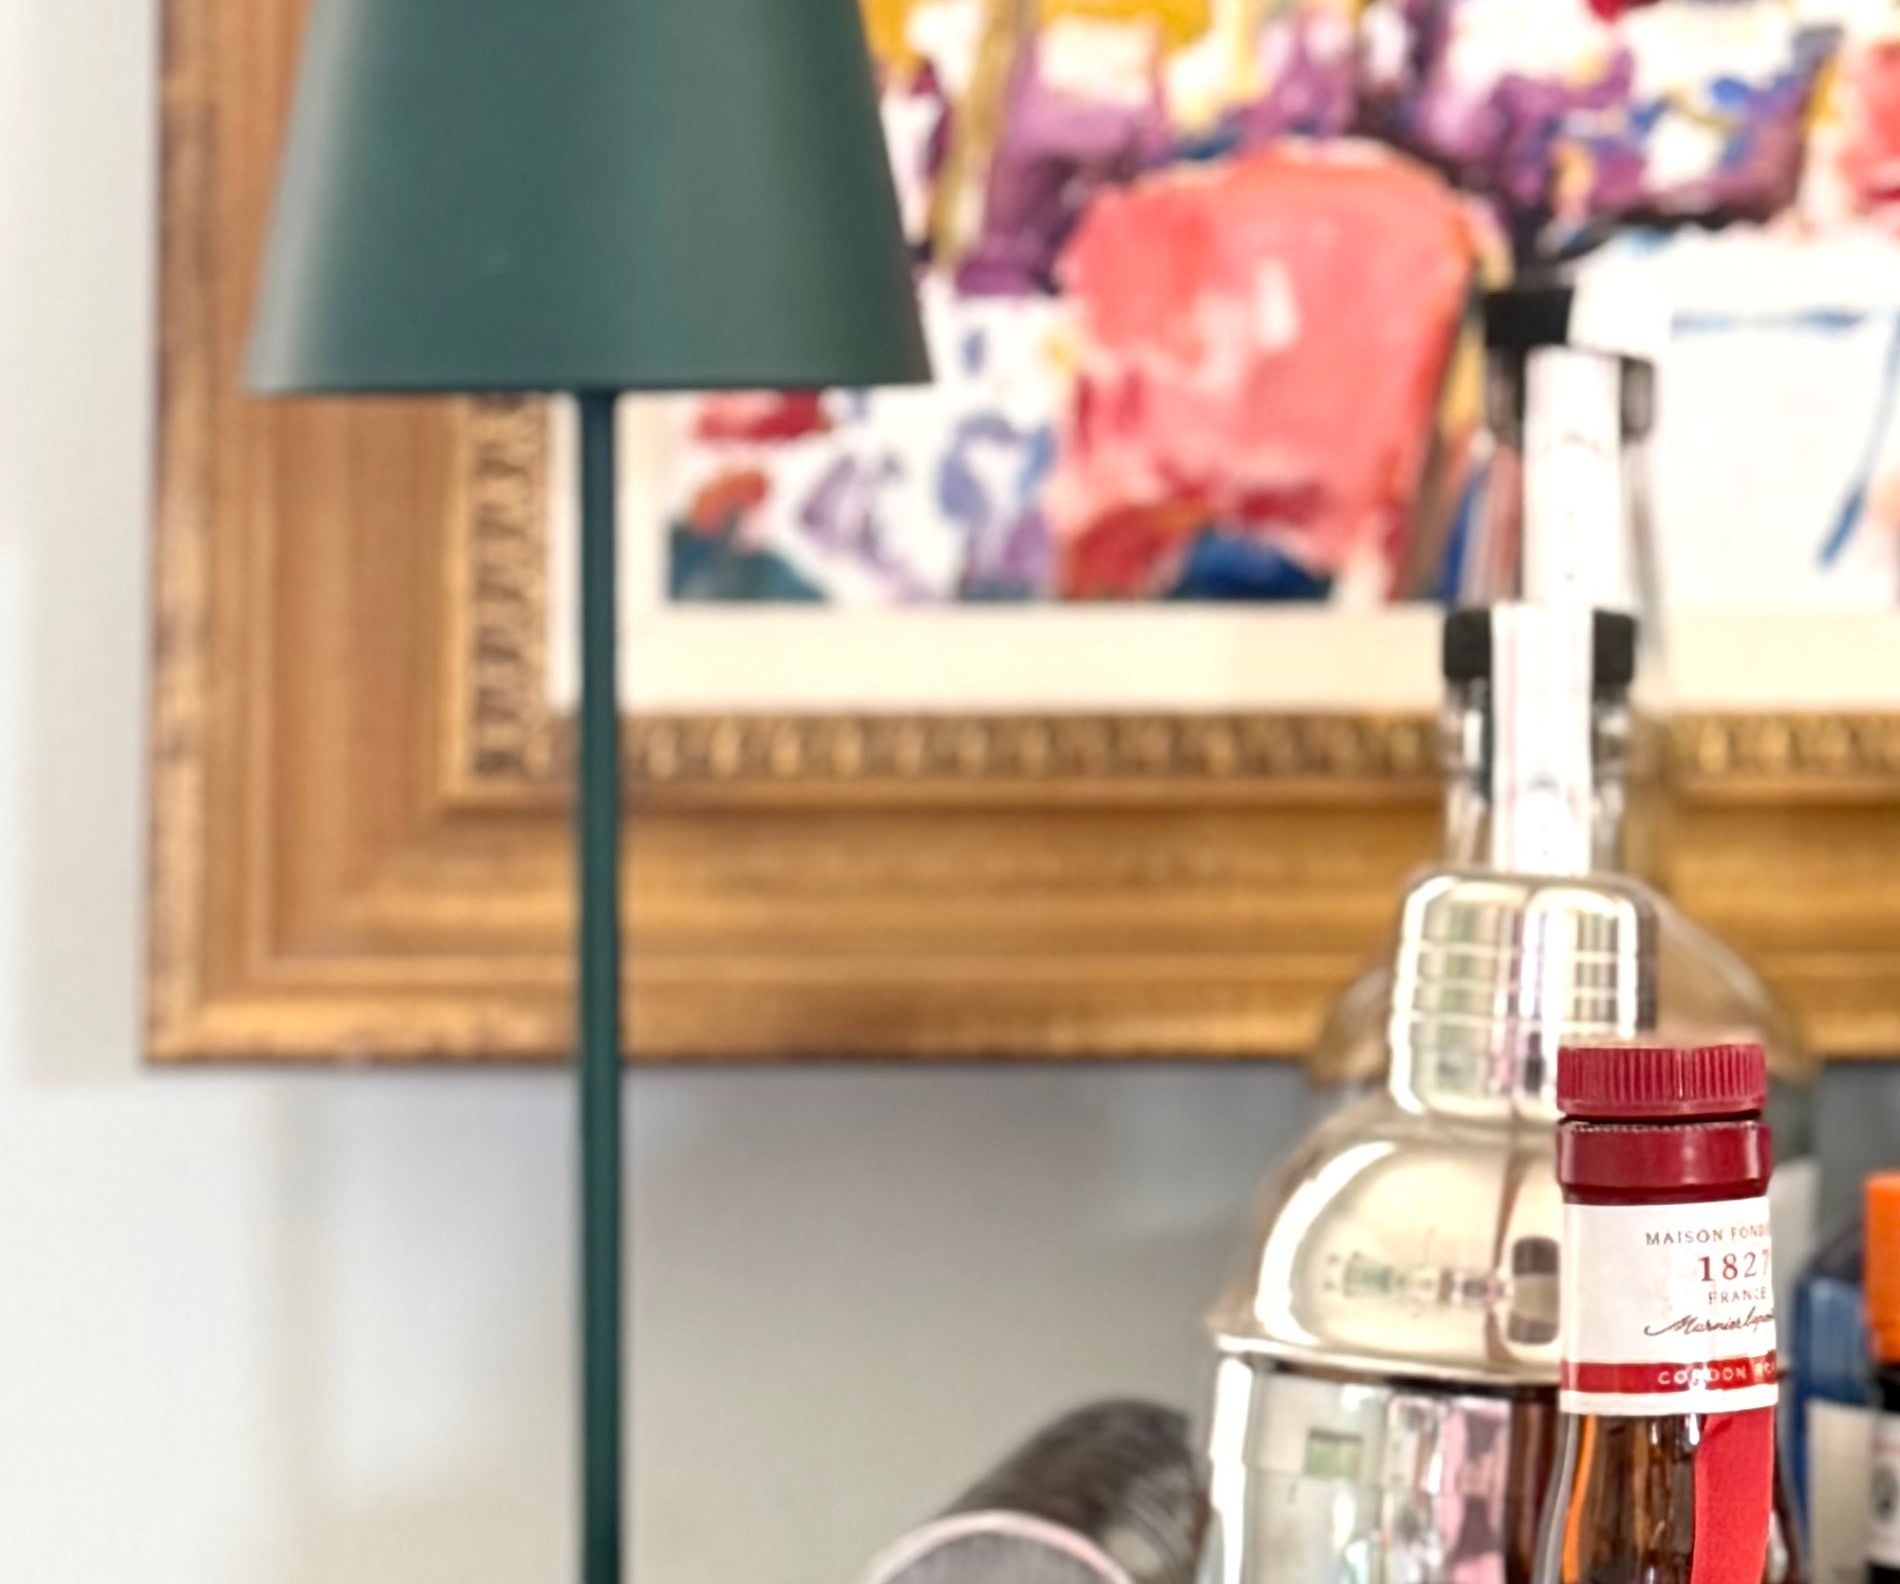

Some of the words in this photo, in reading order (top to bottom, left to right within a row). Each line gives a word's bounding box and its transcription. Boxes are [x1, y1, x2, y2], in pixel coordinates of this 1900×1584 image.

[1645, 1228, 1723, 1246] MAISON
[1730, 1224, 1769, 1241] FOND
[1697, 1248, 1770, 1282] 1827
[1707, 1285, 1766, 1305] FRANCE
[1657, 1366, 1748, 1386] CORDON
